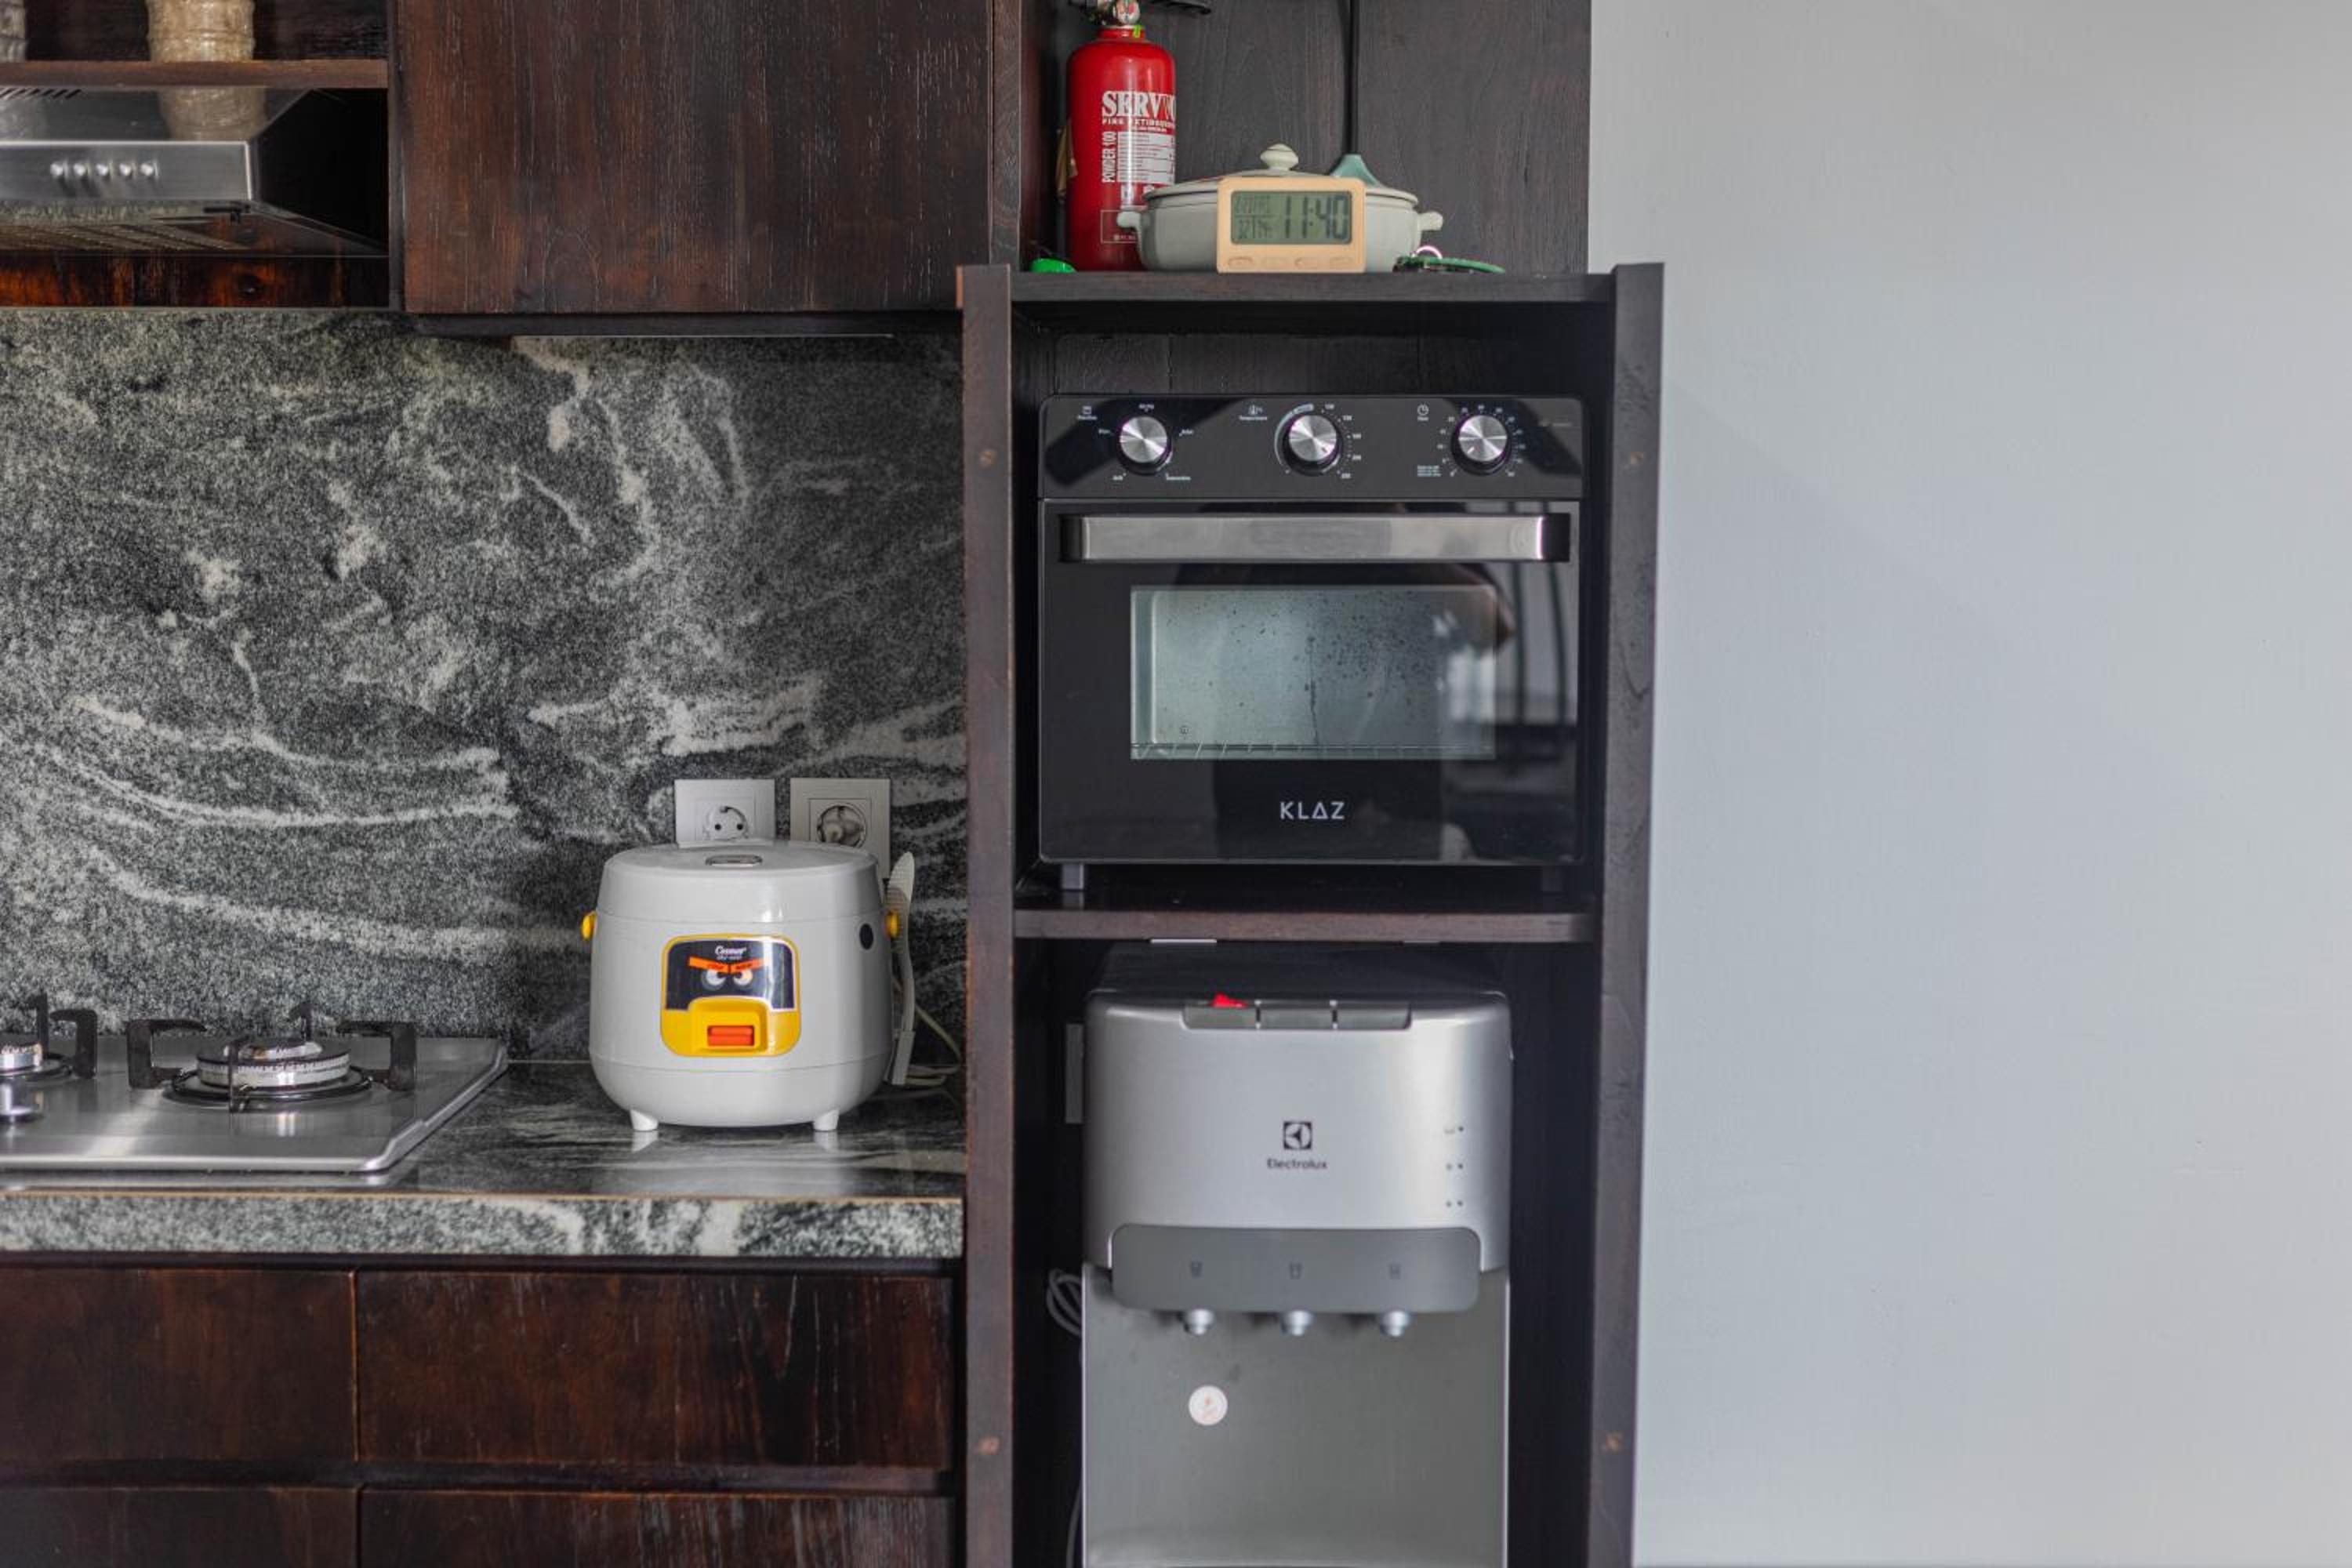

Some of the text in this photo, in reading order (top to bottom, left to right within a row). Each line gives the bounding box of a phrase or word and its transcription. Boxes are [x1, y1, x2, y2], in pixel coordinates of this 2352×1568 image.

[1102, 131, 1116, 183] POWDER 100
[1283, 195, 1349, 240] 11:40
[1266, 1158, 1328, 1170] Electrolux
